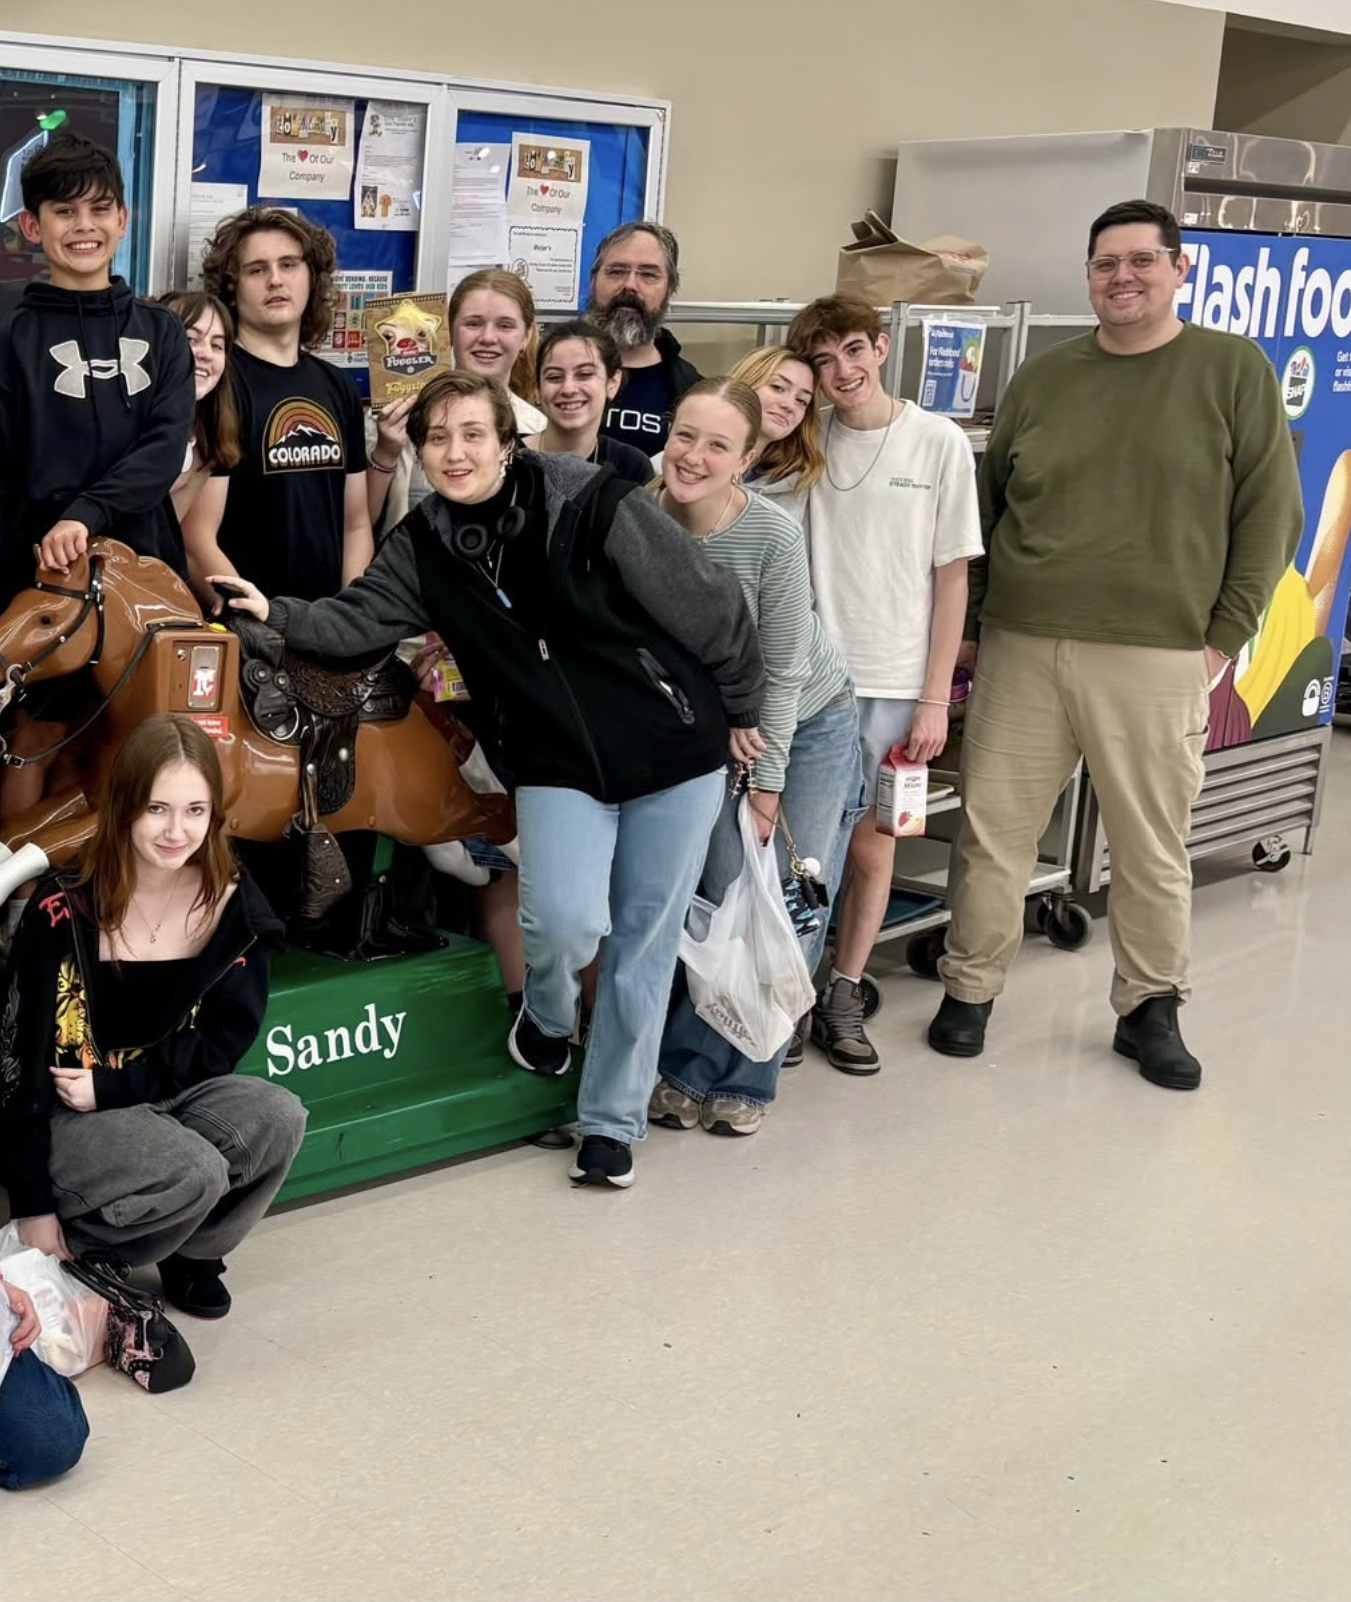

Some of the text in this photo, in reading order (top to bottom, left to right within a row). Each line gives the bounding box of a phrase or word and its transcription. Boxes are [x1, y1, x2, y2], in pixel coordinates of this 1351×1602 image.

[281, 152, 335, 165] The Of Our
[289, 171, 326, 183] Company
[527, 186, 571, 199] The Of Our
[531, 203, 562, 216] Company
[1173, 242, 1281, 338] Flash
[268, 444, 341, 464] COLORADO
[266, 1002, 407, 1078] Sandy
